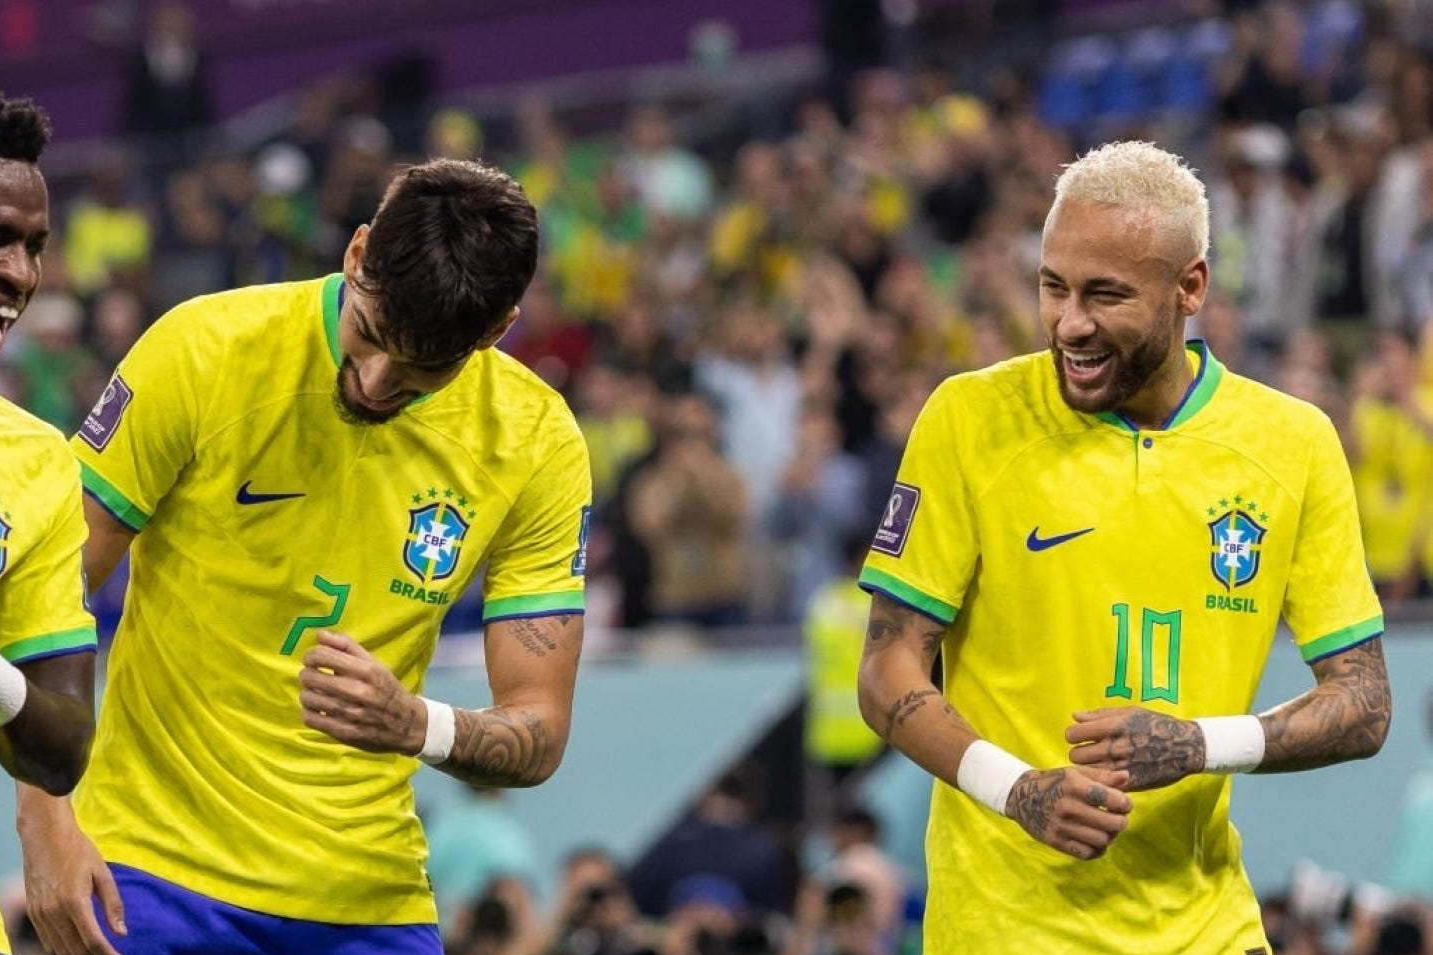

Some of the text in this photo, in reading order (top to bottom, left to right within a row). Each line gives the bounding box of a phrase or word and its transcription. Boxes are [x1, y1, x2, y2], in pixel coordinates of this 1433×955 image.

[423, 533, 448, 548] CBF
[1223, 542, 1244, 554] CBF
[389, 578, 450, 605] BRASIL
[279, 574, 352, 656] 7
[1205, 594, 1258, 614] BRASIL
[1105, 602, 1182, 705] 10
